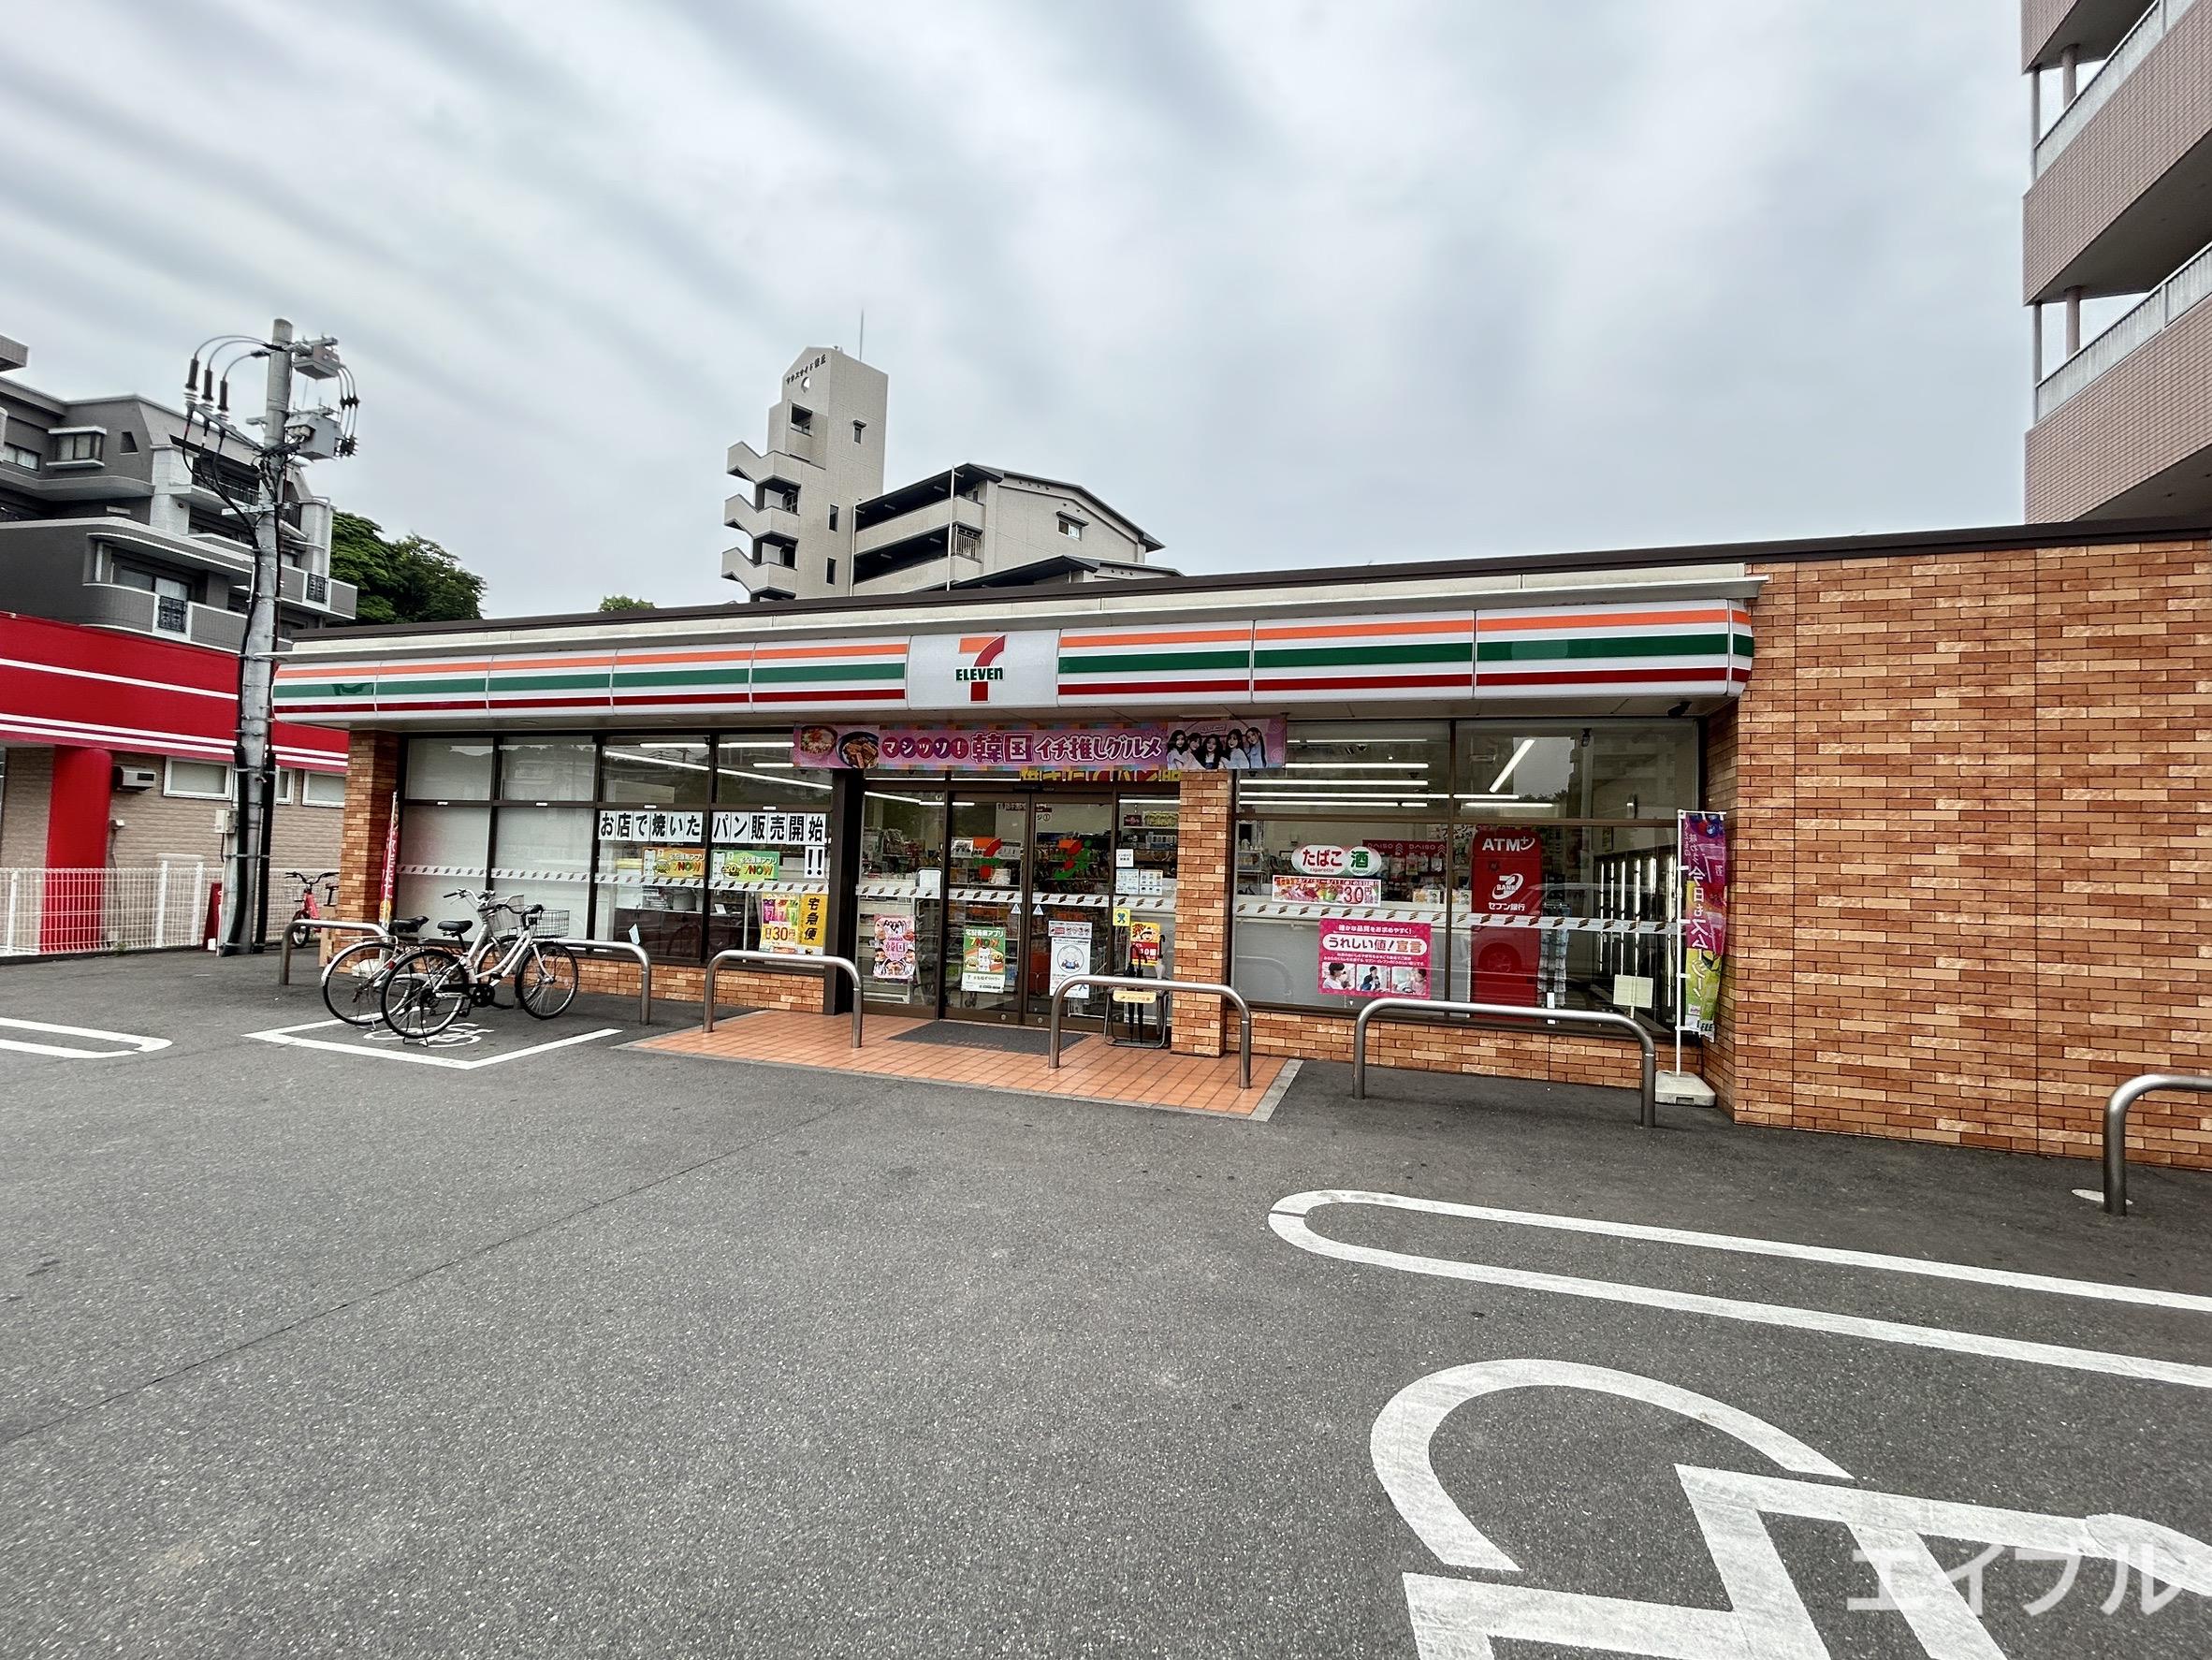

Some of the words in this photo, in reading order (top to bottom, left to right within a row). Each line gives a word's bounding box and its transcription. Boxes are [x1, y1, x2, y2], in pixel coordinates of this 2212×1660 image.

[958, 634, 1007, 702] 7
[600, 812, 702, 840] お店で焼いた
[713, 813, 825, 843] パン販売開始
[1302, 849, 1343, 867] たばこ
[1350, 850, 1369, 868] 酒
[805, 896, 821, 940] 宅急便
[1329, 937, 1422, 954] うれしい値!宣言
